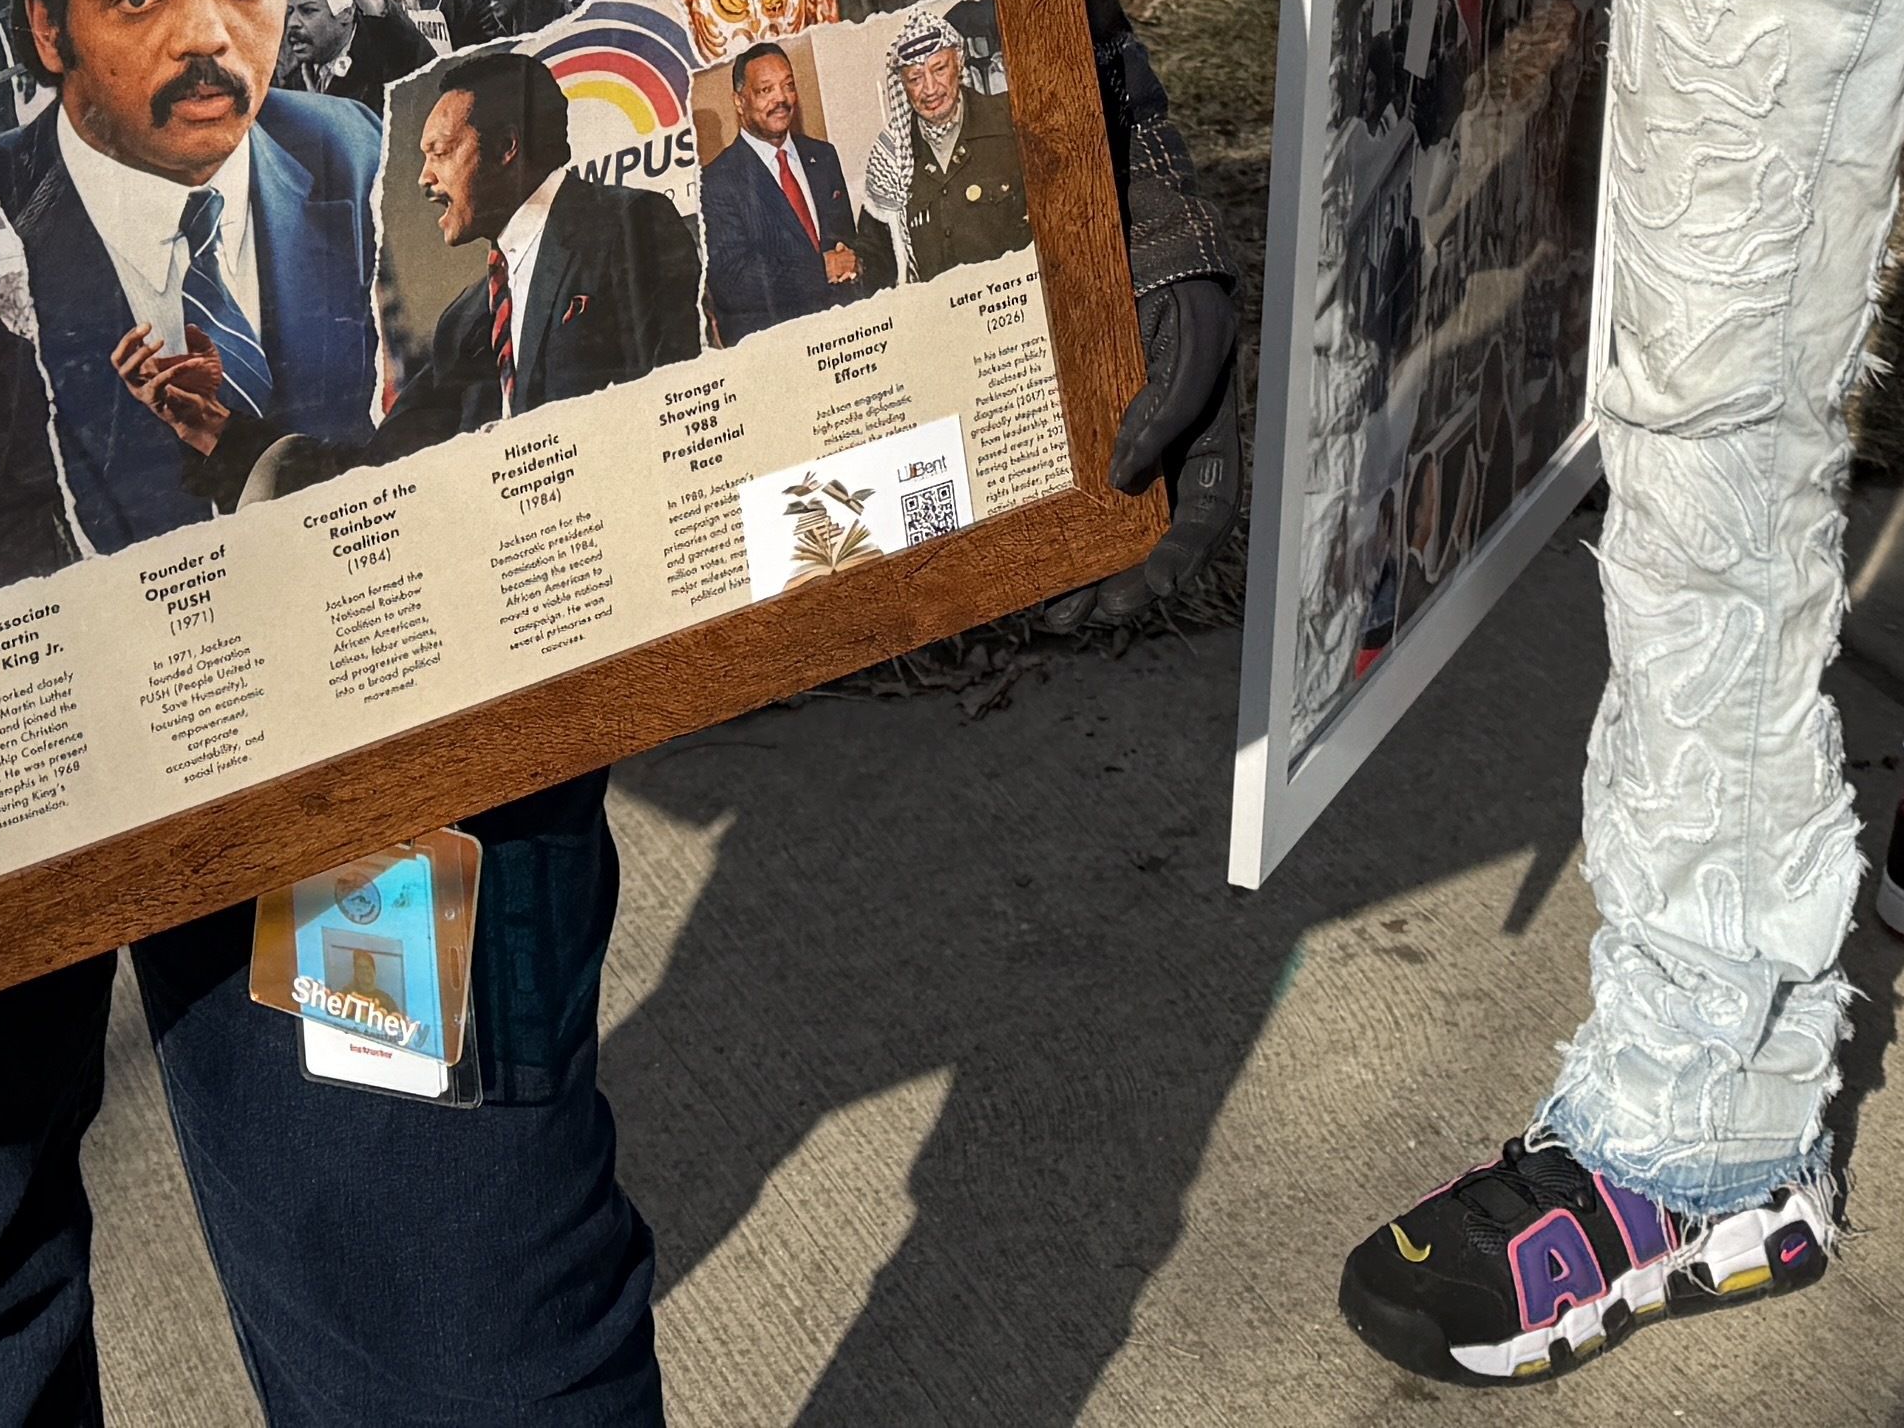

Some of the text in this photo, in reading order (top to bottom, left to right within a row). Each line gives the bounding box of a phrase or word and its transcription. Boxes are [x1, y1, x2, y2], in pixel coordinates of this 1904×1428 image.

[949, 290, 982, 308] Later
[985, 277, 1021, 295] Years
[978, 293, 1027, 316] Passing
[986, 308, 1024, 334] (2026)
[806, 316, 893, 357] International
[817, 340, 887, 371] Diplomacy
[834, 362, 877, 384] Efforts
[664, 377, 725, 405] Stronger
[659, 392, 736, 426] Showing in
[684, 415, 717, 436] 1988
[504, 433, 559, 460] Historic
[662, 423, 744, 463] Presidential
[491, 443, 577, 484] Presidential
[689, 454, 722, 472] Race
[500, 468, 574, 499] Campaign
[303, 483, 416, 528] Creation of the
[519, 487, 561, 515] (1984)
[329, 509, 396, 539] Rainbow
[332, 528, 399, 557] Coalition
[139, 543, 225, 584] Founder of
[347, 546, 390, 575] (1984)
[144, 568, 226, 601] Operation
[166, 589, 210, 614] PUSH
[170, 607, 214, 636] (1971)
[1, 650, 39, 670] King
[45, 642, 63, 656] Jr.
[0, 699, 36, 720] Martin
[39, 687, 71, 705] Luther
[59, 701, 77, 714] the
[4, 767, 20, 779] He
[23, 760, 45, 772] was
